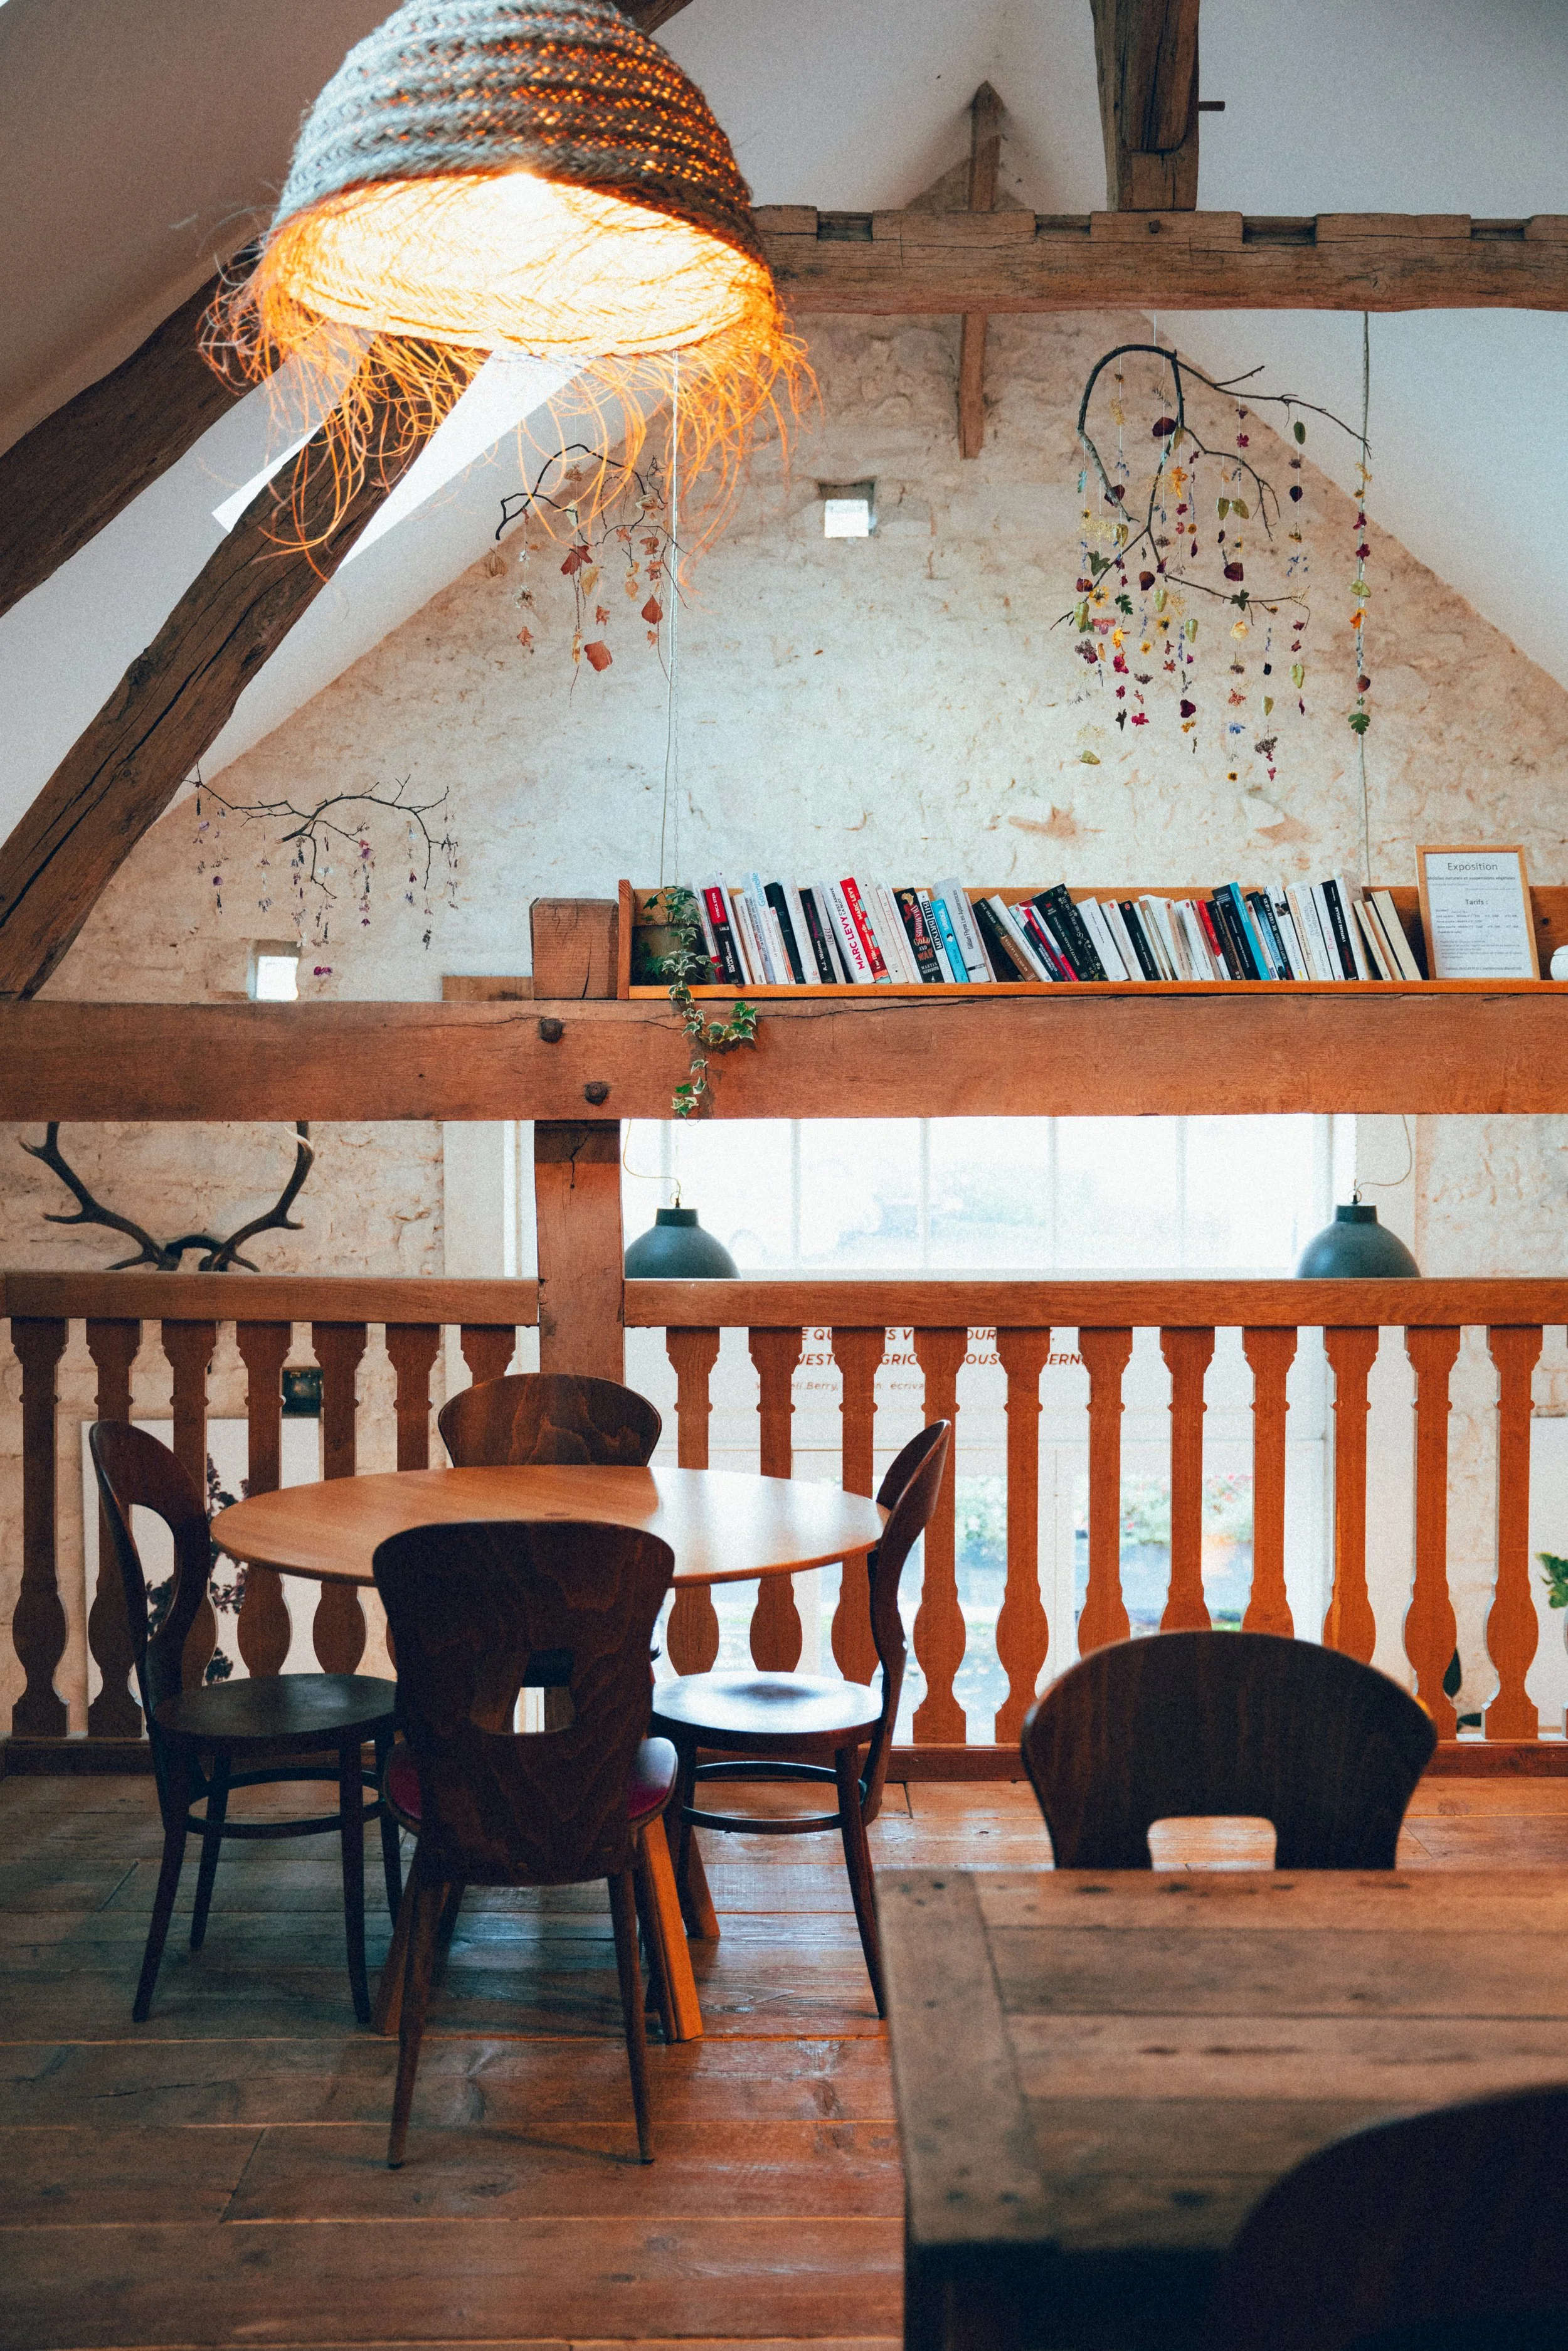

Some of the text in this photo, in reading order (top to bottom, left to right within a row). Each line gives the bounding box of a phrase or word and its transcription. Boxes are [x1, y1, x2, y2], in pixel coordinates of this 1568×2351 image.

[1448, 862, 1498, 872] Exposition
[753, 873, 765, 907] Gounelle
[847, 887, 862, 919] MARC LEVY
[952, 889, 963, 915] Apparences
[911, 905, 923, 937] DIAMONDS
[923, 901, 944, 948] BILL BRYSON
[1054, 917, 1062, 931] VIENNE
[1307, 901, 1320, 937] UN MENSONGE
[840, 916, 864, 969] MARC LEVY
[914, 937, 931, 946] GOLD
[965, 936, 973, 949] Gillian
[1064, 937, 1073, 951] JAMAIS
[918, 948, 933, 961] WAR
[1071, 951, 1079, 965] MINUIT
[922, 966, 940, 975] MEREDITH
[968, 1329, 996, 1340] OUR
[882, 1354, 918, 1365] GRIC
[966, 1354, 998, 1365] OUS
[1049, 1354, 1083, 1365] ERN
[890, 1381, 924, 1390] écriva
